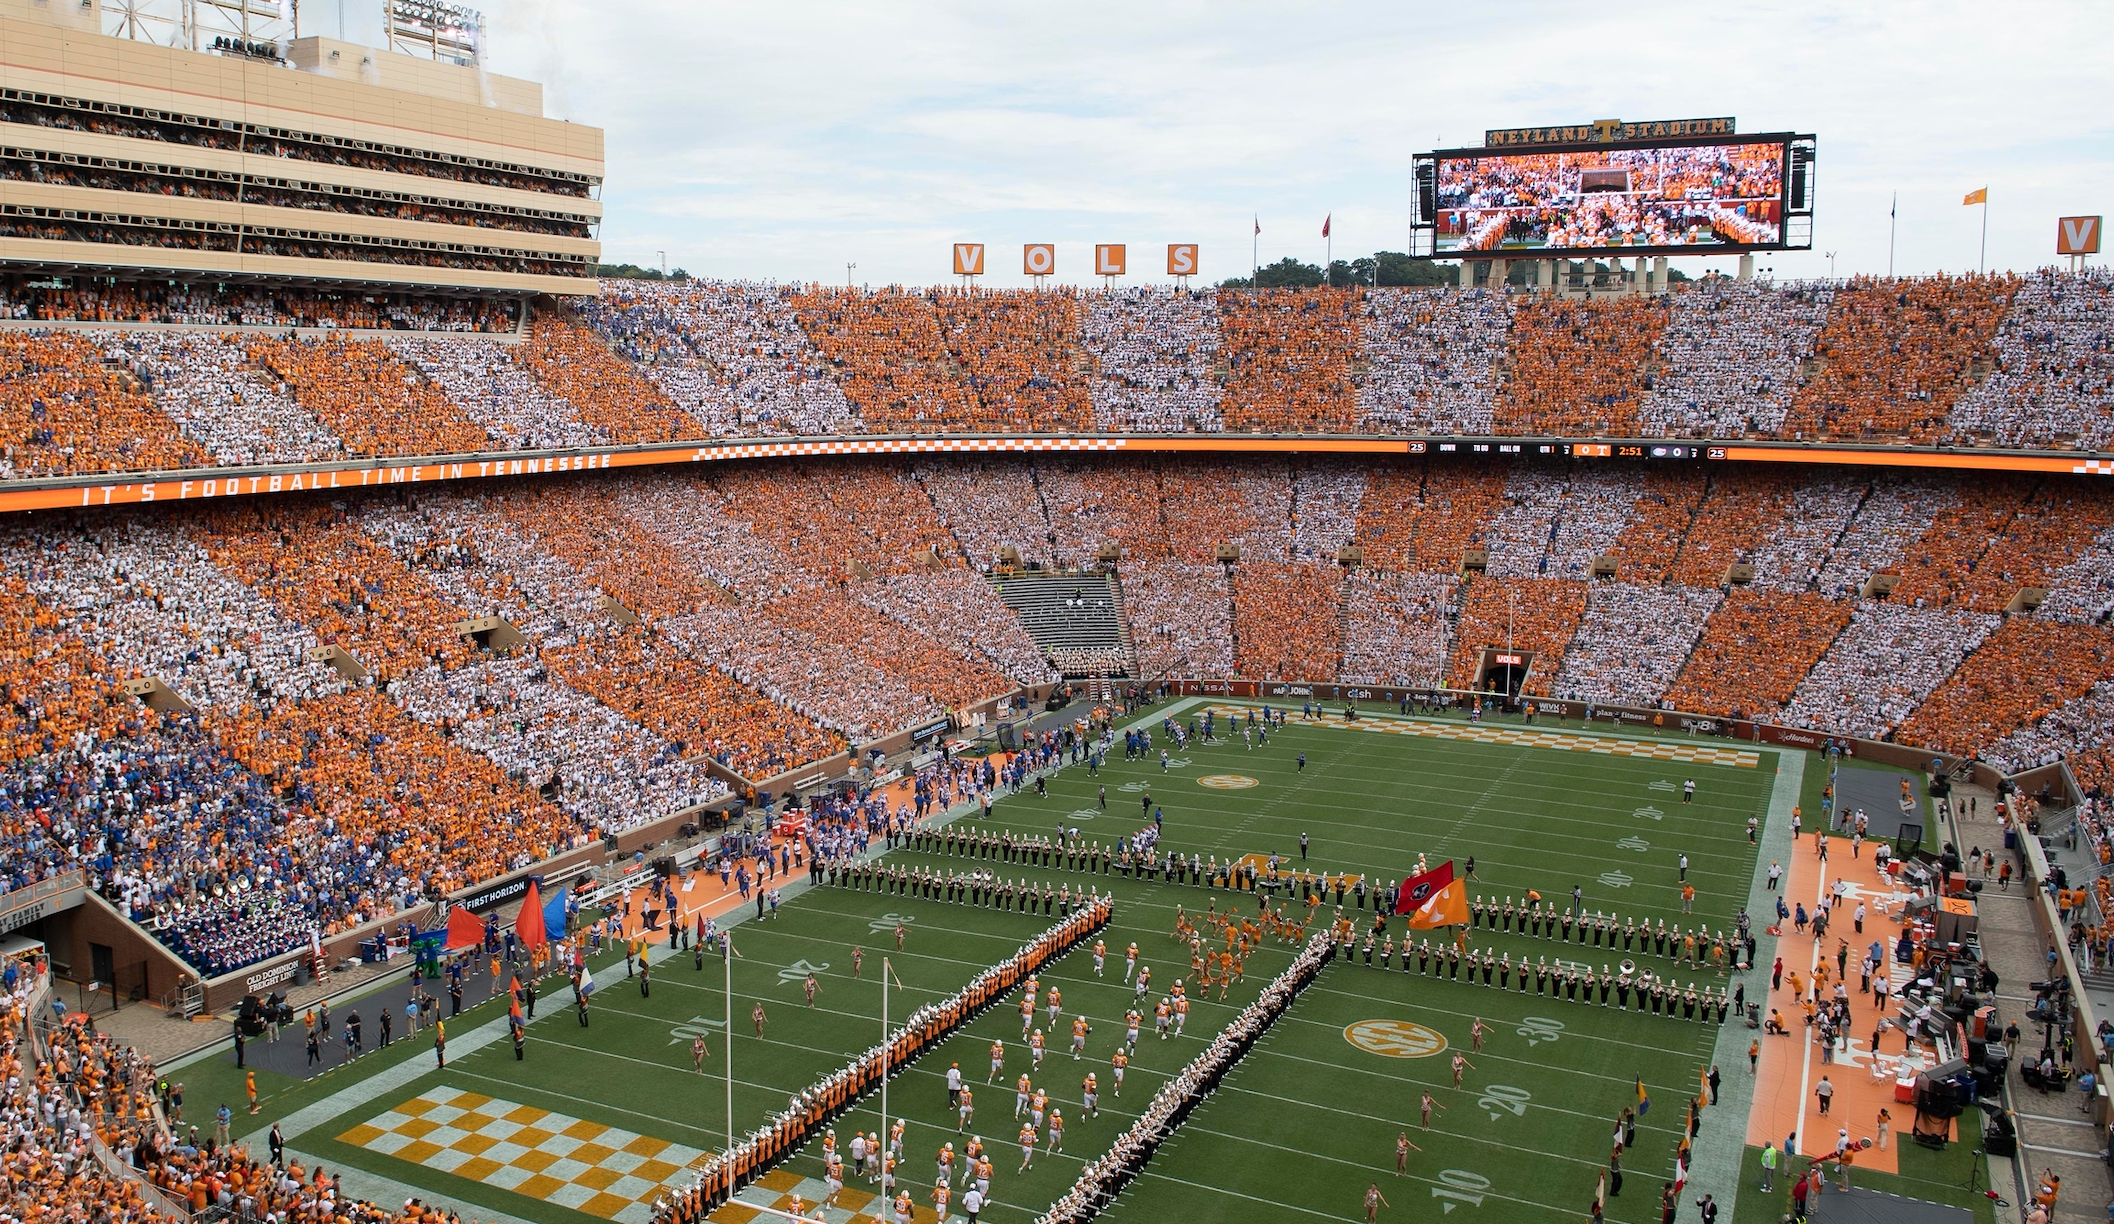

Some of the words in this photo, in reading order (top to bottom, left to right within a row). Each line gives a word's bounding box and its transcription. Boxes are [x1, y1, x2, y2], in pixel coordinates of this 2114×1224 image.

[1493, 127, 1588, 145] NEYLAND
[1594, 119, 1620, 142] T
[1625, 119, 1727, 138] STADIUM
[2063, 219, 2095, 251] V
[958, 246, 981, 272] V
[1027, 246, 1051, 272] O
[1100, 247, 1120, 272] L
[1173, 246, 1193, 272] S
[1410, 443, 1424, 451] 25
[1440, 444, 1456, 452] DOWN
[1582, 446, 1590, 454] 0
[1619, 447, 1643, 456] 2:51
[1673, 448, 1682, 457] 0
[1710, 449, 1725, 458] 25
[82, 484, 156, 506] IT'S
[181, 471, 340, 499] FOOTBALL
[361, 466, 422, 485] TIME
[440, 463, 463, 480] IN
[479, 455, 610, 477] TENNESSEE
[1497, 655, 1520, 664] VOLS
[467, 894, 489, 910] FIRST
[490, 881, 525, 901] HORIZON
[8, 912, 41, 930] CENTER
[12, 902, 45, 921] FAMILY
[246, 974, 262, 986] OLD
[262, 960, 299, 979] DOMINION
[248, 975, 280, 994] FREIGHT
[1516, 1016, 1565, 1042] 30
[1478, 1084, 1532, 1116] 20
[1431, 1169, 1491, 1208] 10
